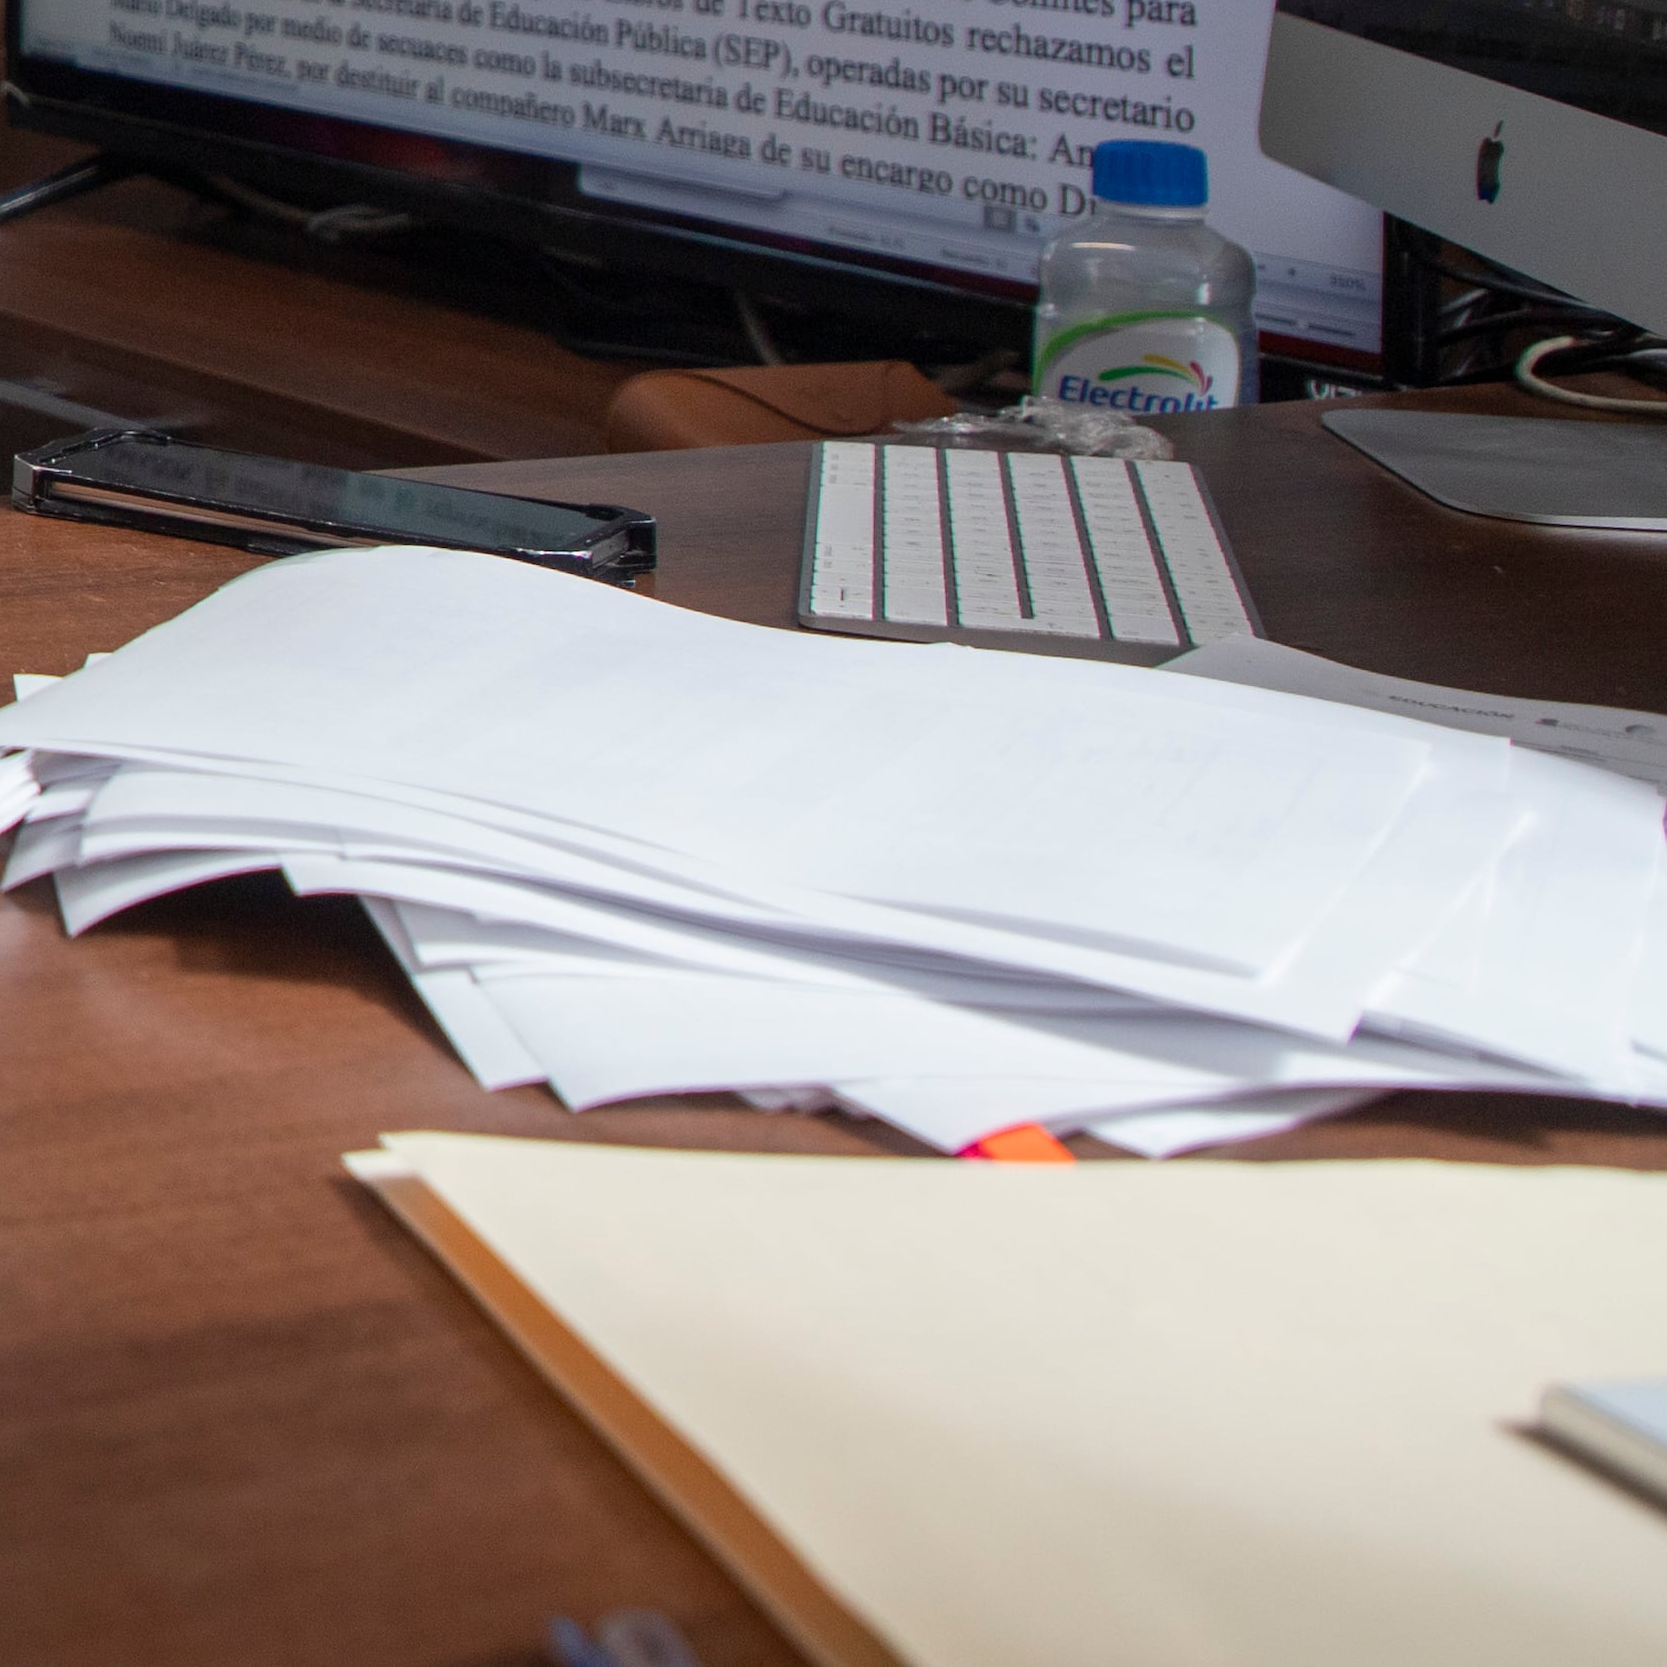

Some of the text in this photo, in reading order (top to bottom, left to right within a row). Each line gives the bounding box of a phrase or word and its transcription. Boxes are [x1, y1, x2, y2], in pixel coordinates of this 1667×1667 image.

[822, 0, 954, 47] Gratuitos
[968, 23, 1150, 74] rechazamos
[1167, 44, 1194, 80] el
[735, 81, 766, 116] de
[929, 112, 1037, 161] Básica:
[806, 54, 931, 94] operadas
[938, 73, 989, 107] por
[997, 81, 1028, 109] su
[1038, 87, 1195, 133] secretario
[655, 114, 751, 160] Arriaga
[761, 131, 791, 167] de
[801, 147, 830, 174] su
[842, 154, 953, 196] encargo
[964, 175, 1048, 213] como
